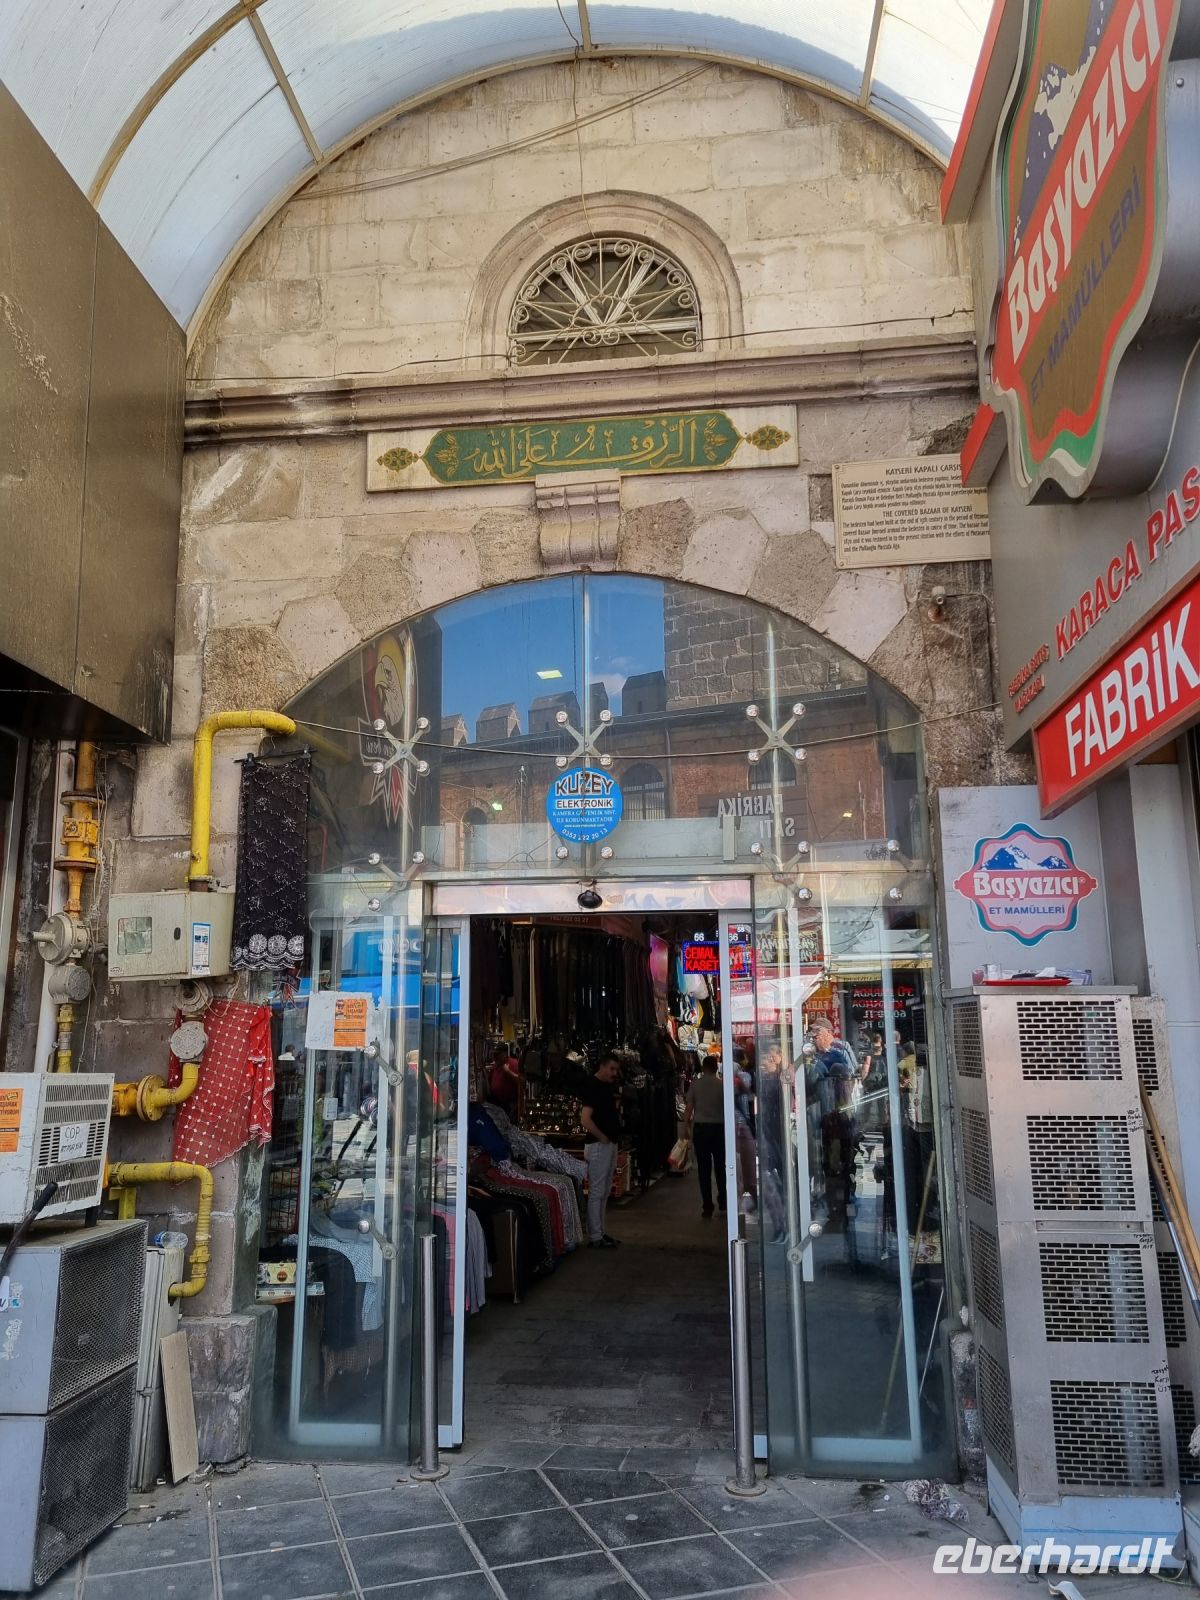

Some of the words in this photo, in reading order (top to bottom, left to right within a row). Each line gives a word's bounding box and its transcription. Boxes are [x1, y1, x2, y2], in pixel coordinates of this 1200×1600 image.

[1056, 540, 1142, 660] KARACA
[555, 771, 615, 796] KUZEY
[973, 872, 1079, 901] Başyazıcı
[989, 907, 1001, 915] ET
[1004, 904, 1065, 914] MAMÜLLERİ
[694, 932, 704, 941] 66
